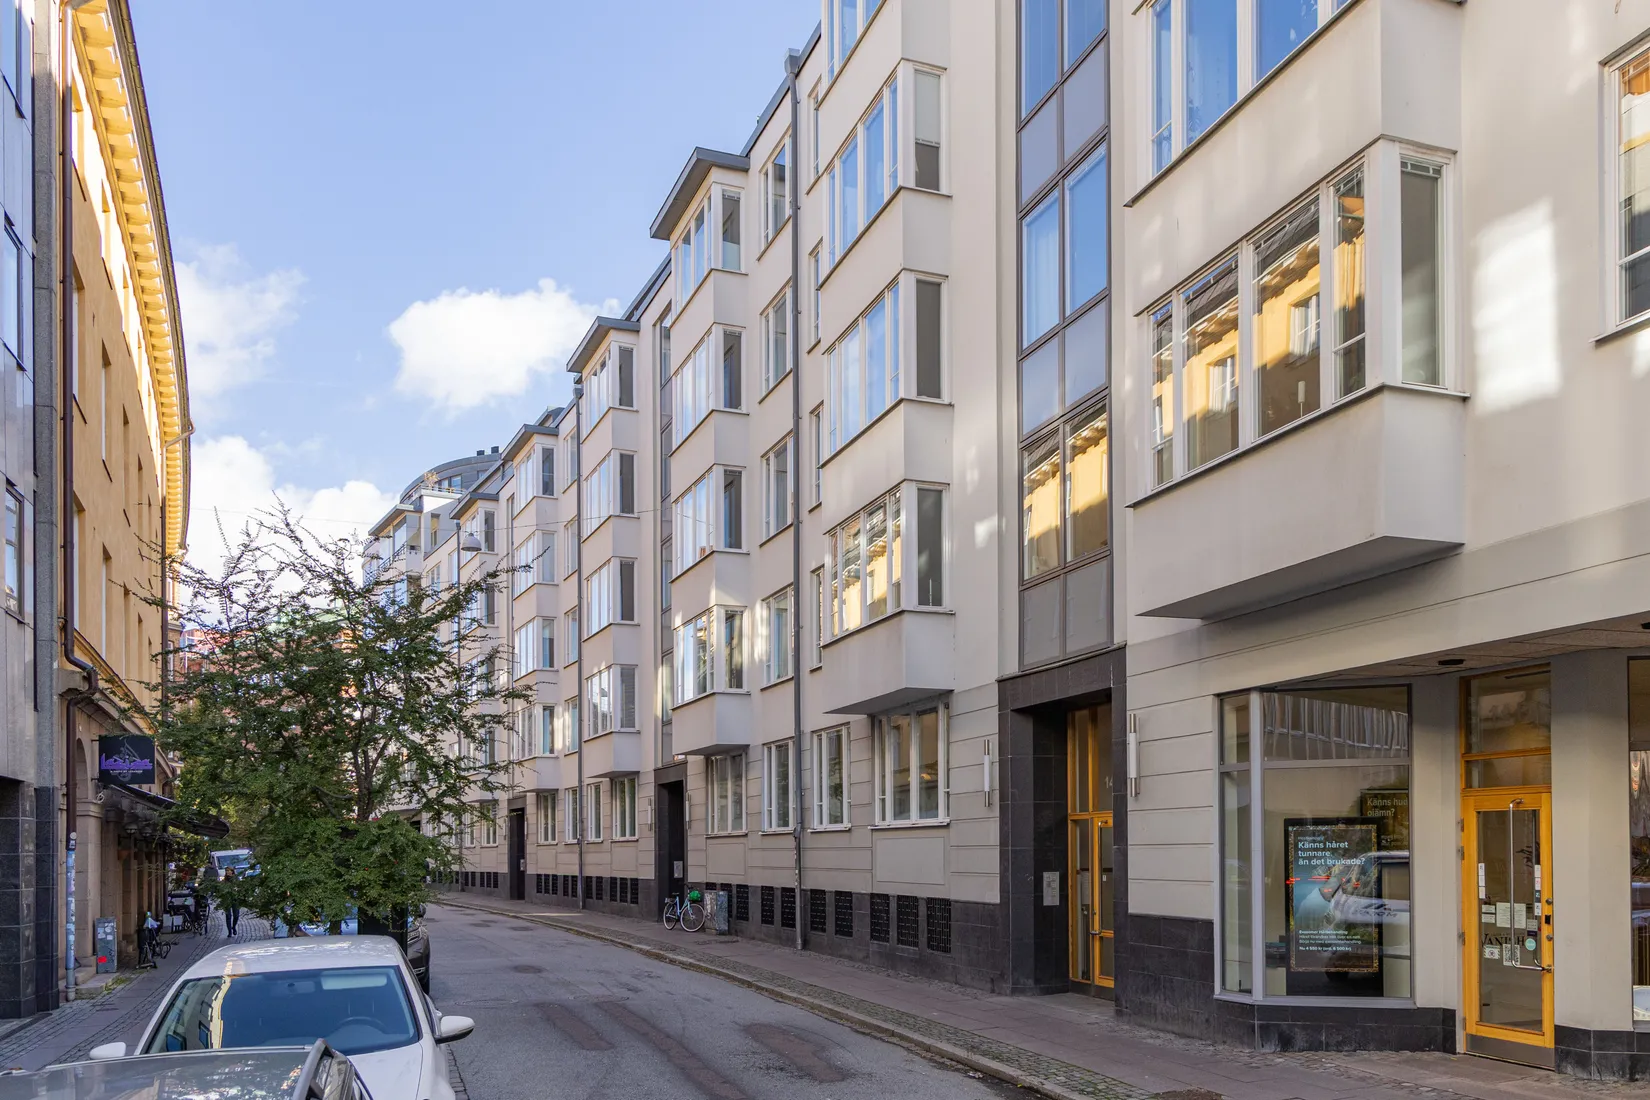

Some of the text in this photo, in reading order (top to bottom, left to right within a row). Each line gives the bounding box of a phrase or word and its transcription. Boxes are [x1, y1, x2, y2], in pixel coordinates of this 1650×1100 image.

[1367, 797, 1392, 806] Känns
[1298, 840, 1349, 849] Känns håret
[1327, 857, 1366, 865] brukade?
